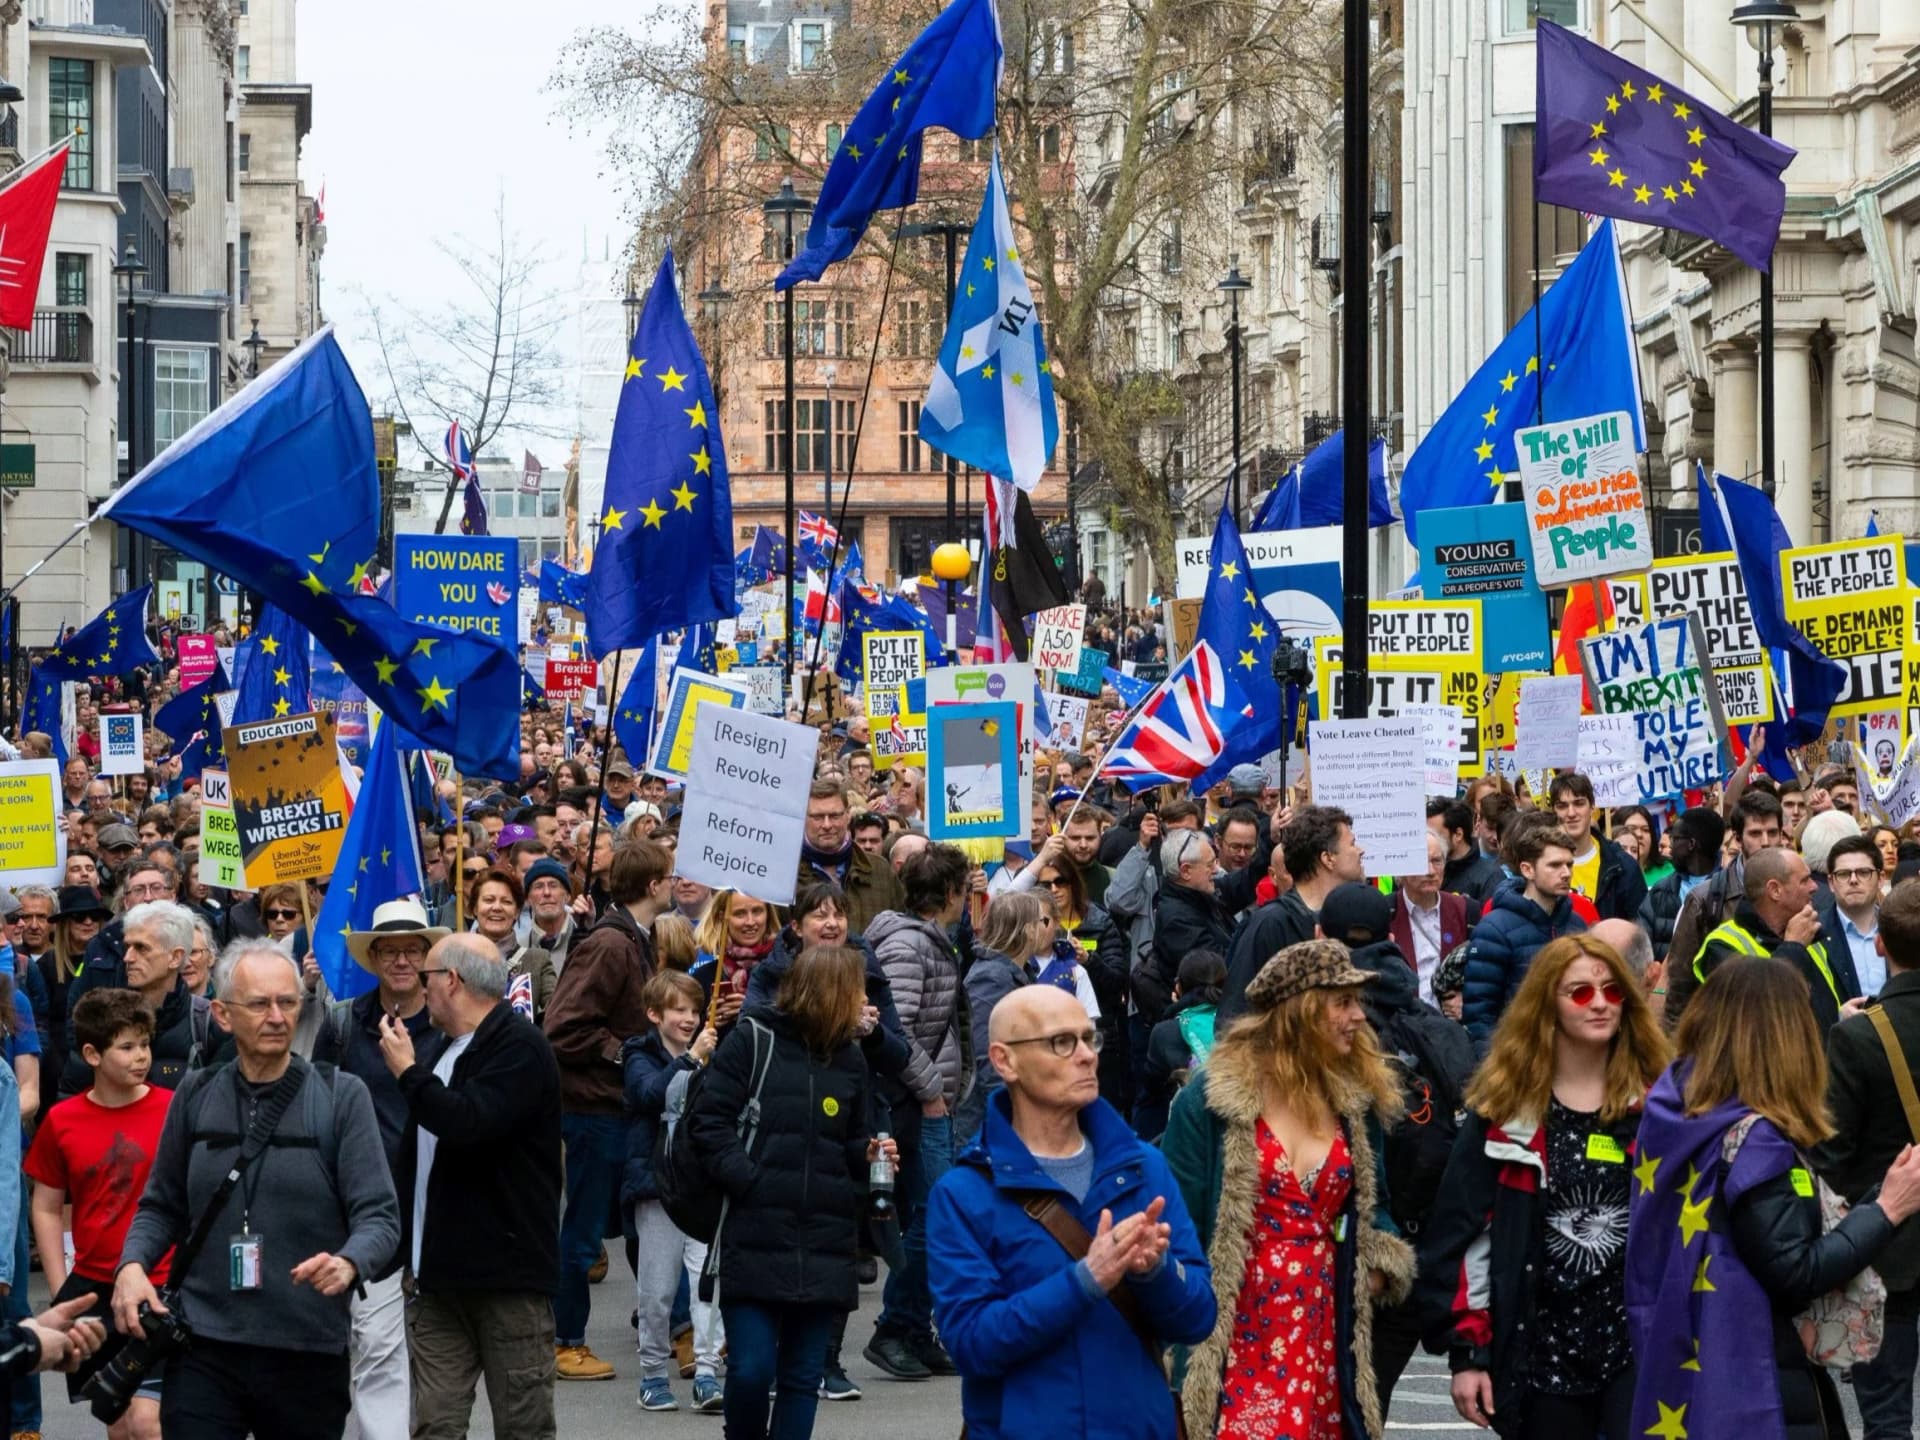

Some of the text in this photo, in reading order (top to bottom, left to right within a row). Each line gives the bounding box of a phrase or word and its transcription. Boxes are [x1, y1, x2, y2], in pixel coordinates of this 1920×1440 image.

[1522, 430, 1570, 463] The
[1561, 452, 1588, 479] of
[1537, 470, 1638, 512] a few rich
[1549, 516, 1637, 569] People
[1674, 528, 1702, 554] 16
[411, 550, 505, 572] HOW DARE
[1184, 545, 1293, 567] REFNDUM
[1440, 542, 1509, 562] YOUNG
[1445, 561, 1528, 578] CONSERVATIVES
[1792, 548, 1892, 582] PUT IT TO
[440, 583, 476, 603] YOU
[1440, 579, 1524, 594] FOR A PEOPLE'S VOTE
[1652, 565, 1747, 603] PUT IT
[1794, 570, 1894, 599] THE PEOPLE
[1697, 596, 1751, 628] THE
[1826, 605, 1903, 635] DEMAND
[1368, 612, 1469, 635] PUT IT TO
[869, 638, 918, 654] PUT IT
[1368, 635, 1470, 652] THE PEOPLE
[1587, 618, 1688, 685] I'M 17
[1812, 627, 1903, 656] PEOPLE'S
[869, 654, 918, 670] TO THE
[1039, 651, 1073, 668] NOW!
[1501, 651, 1545, 663] #YC4PV
[1740, 655, 1761, 665] VOTE
[554, 663, 593, 674] Brexit:
[564, 676, 583, 686] is it
[1067, 675, 1095, 689] NOT
[1406, 677, 1435, 704] IT
[1602, 667, 1702, 714] BREXIT
[547, 689, 581, 698] worth
[1750, 687, 1758, 701] A
[1727, 702, 1760, 718] VOTE
[241, 719, 315, 742] EDUCATION
[1870, 714, 1885, 729] OF
[1888, 714, 1898, 730] A
[714, 720, 787, 759] [Resign]
[875, 731, 892, 744] PUT
[1316, 730, 1339, 740] Vote
[1341, 730, 1372, 739] Leave
[1374, 726, 1415, 737] Cheated
[1484, 723, 1504, 742] 19
[877, 742, 926, 755] THE EOPL
[1592, 739, 1613, 756] IS
[1643, 733, 1689, 765] MY
[715, 757, 782, 790] Revoke
[8, 795, 34, 805] BORN
[205, 779, 227, 801] UK
[260, 800, 323, 825] BREXIT
[10, 824, 52, 834] WE HAVE
[246, 813, 341, 844] WRECKS IT
[707, 812, 774, 845] Reform
[205, 839, 242, 858] WREC
[272, 849, 301, 861] Liberal
[274, 856, 323, 870] Democrats
[703, 845, 768, 878] Rejoice
[221, 867, 235, 882] IT
